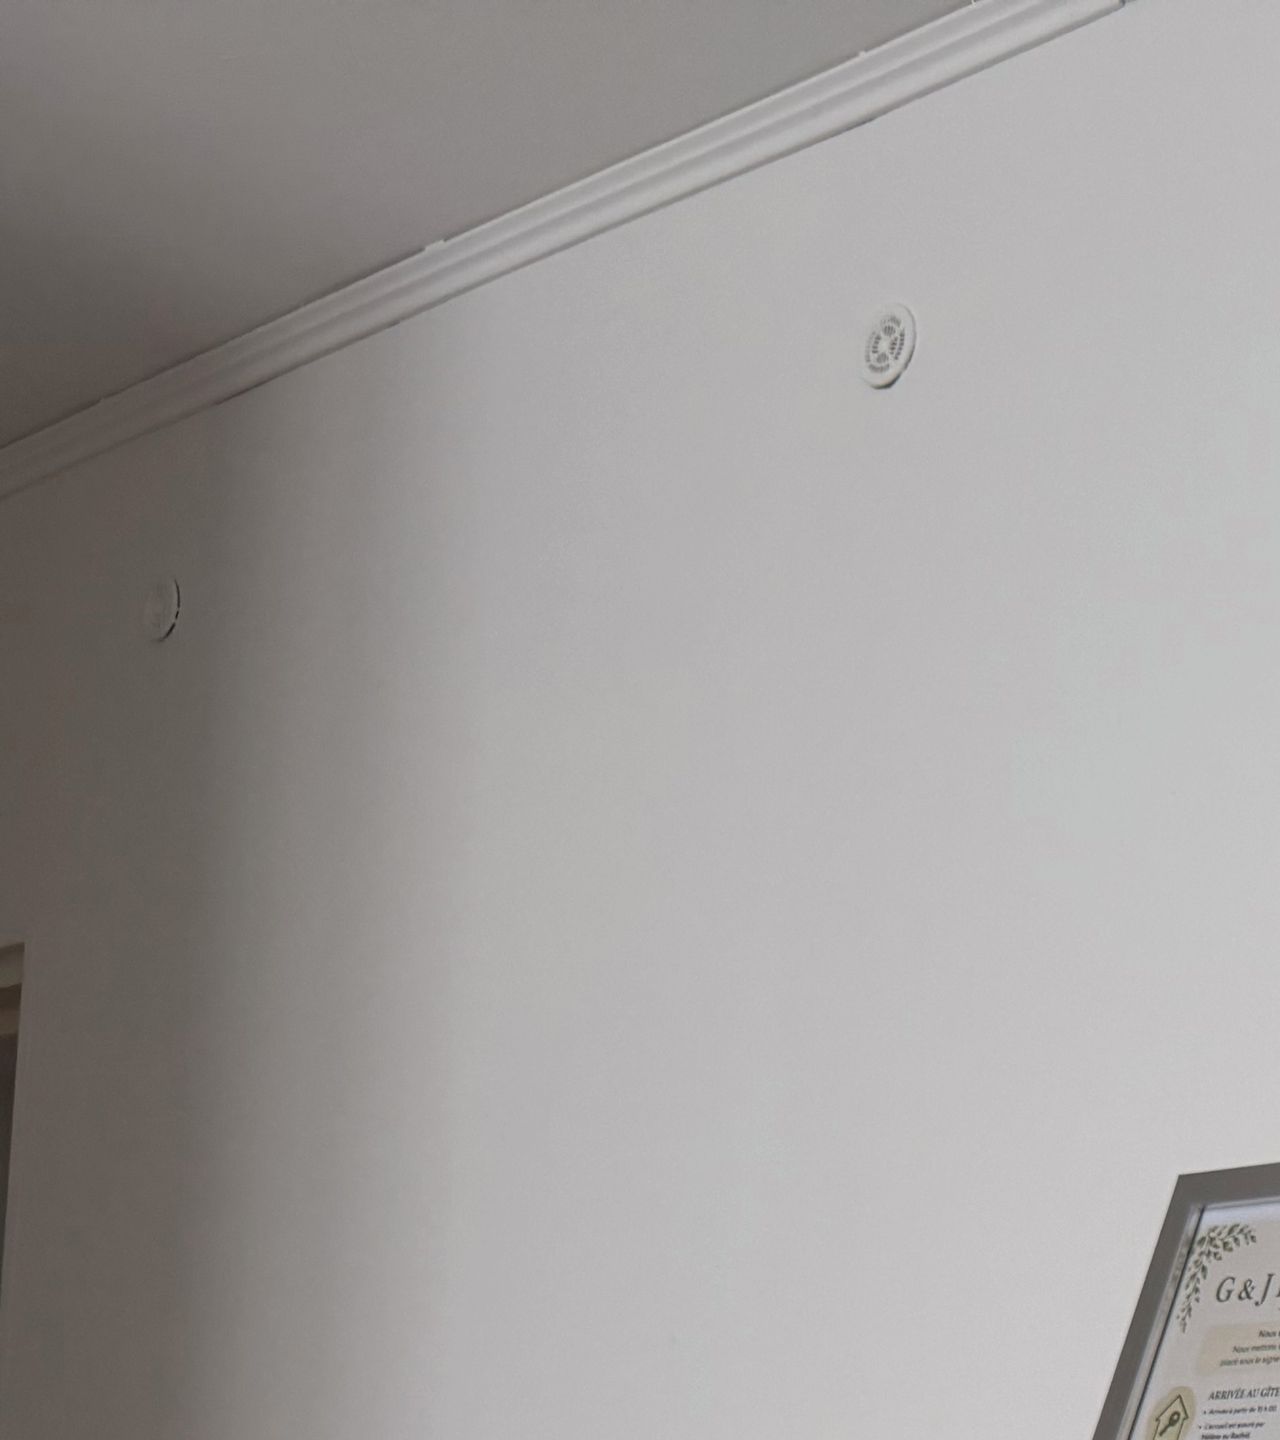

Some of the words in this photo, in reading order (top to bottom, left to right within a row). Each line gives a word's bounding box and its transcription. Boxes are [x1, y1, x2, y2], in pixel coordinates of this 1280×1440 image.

[1215, 1276, 1236, 1303] G
[1237, 1279, 1255, 1301] &
[1254, 1273, 1274, 1307] J
[1208, 1388, 1245, 1401] ARRIVÉE
[1246, 1388, 1260, 1398] AU
[1259, 1386, 1280, 1398] GÎTE
